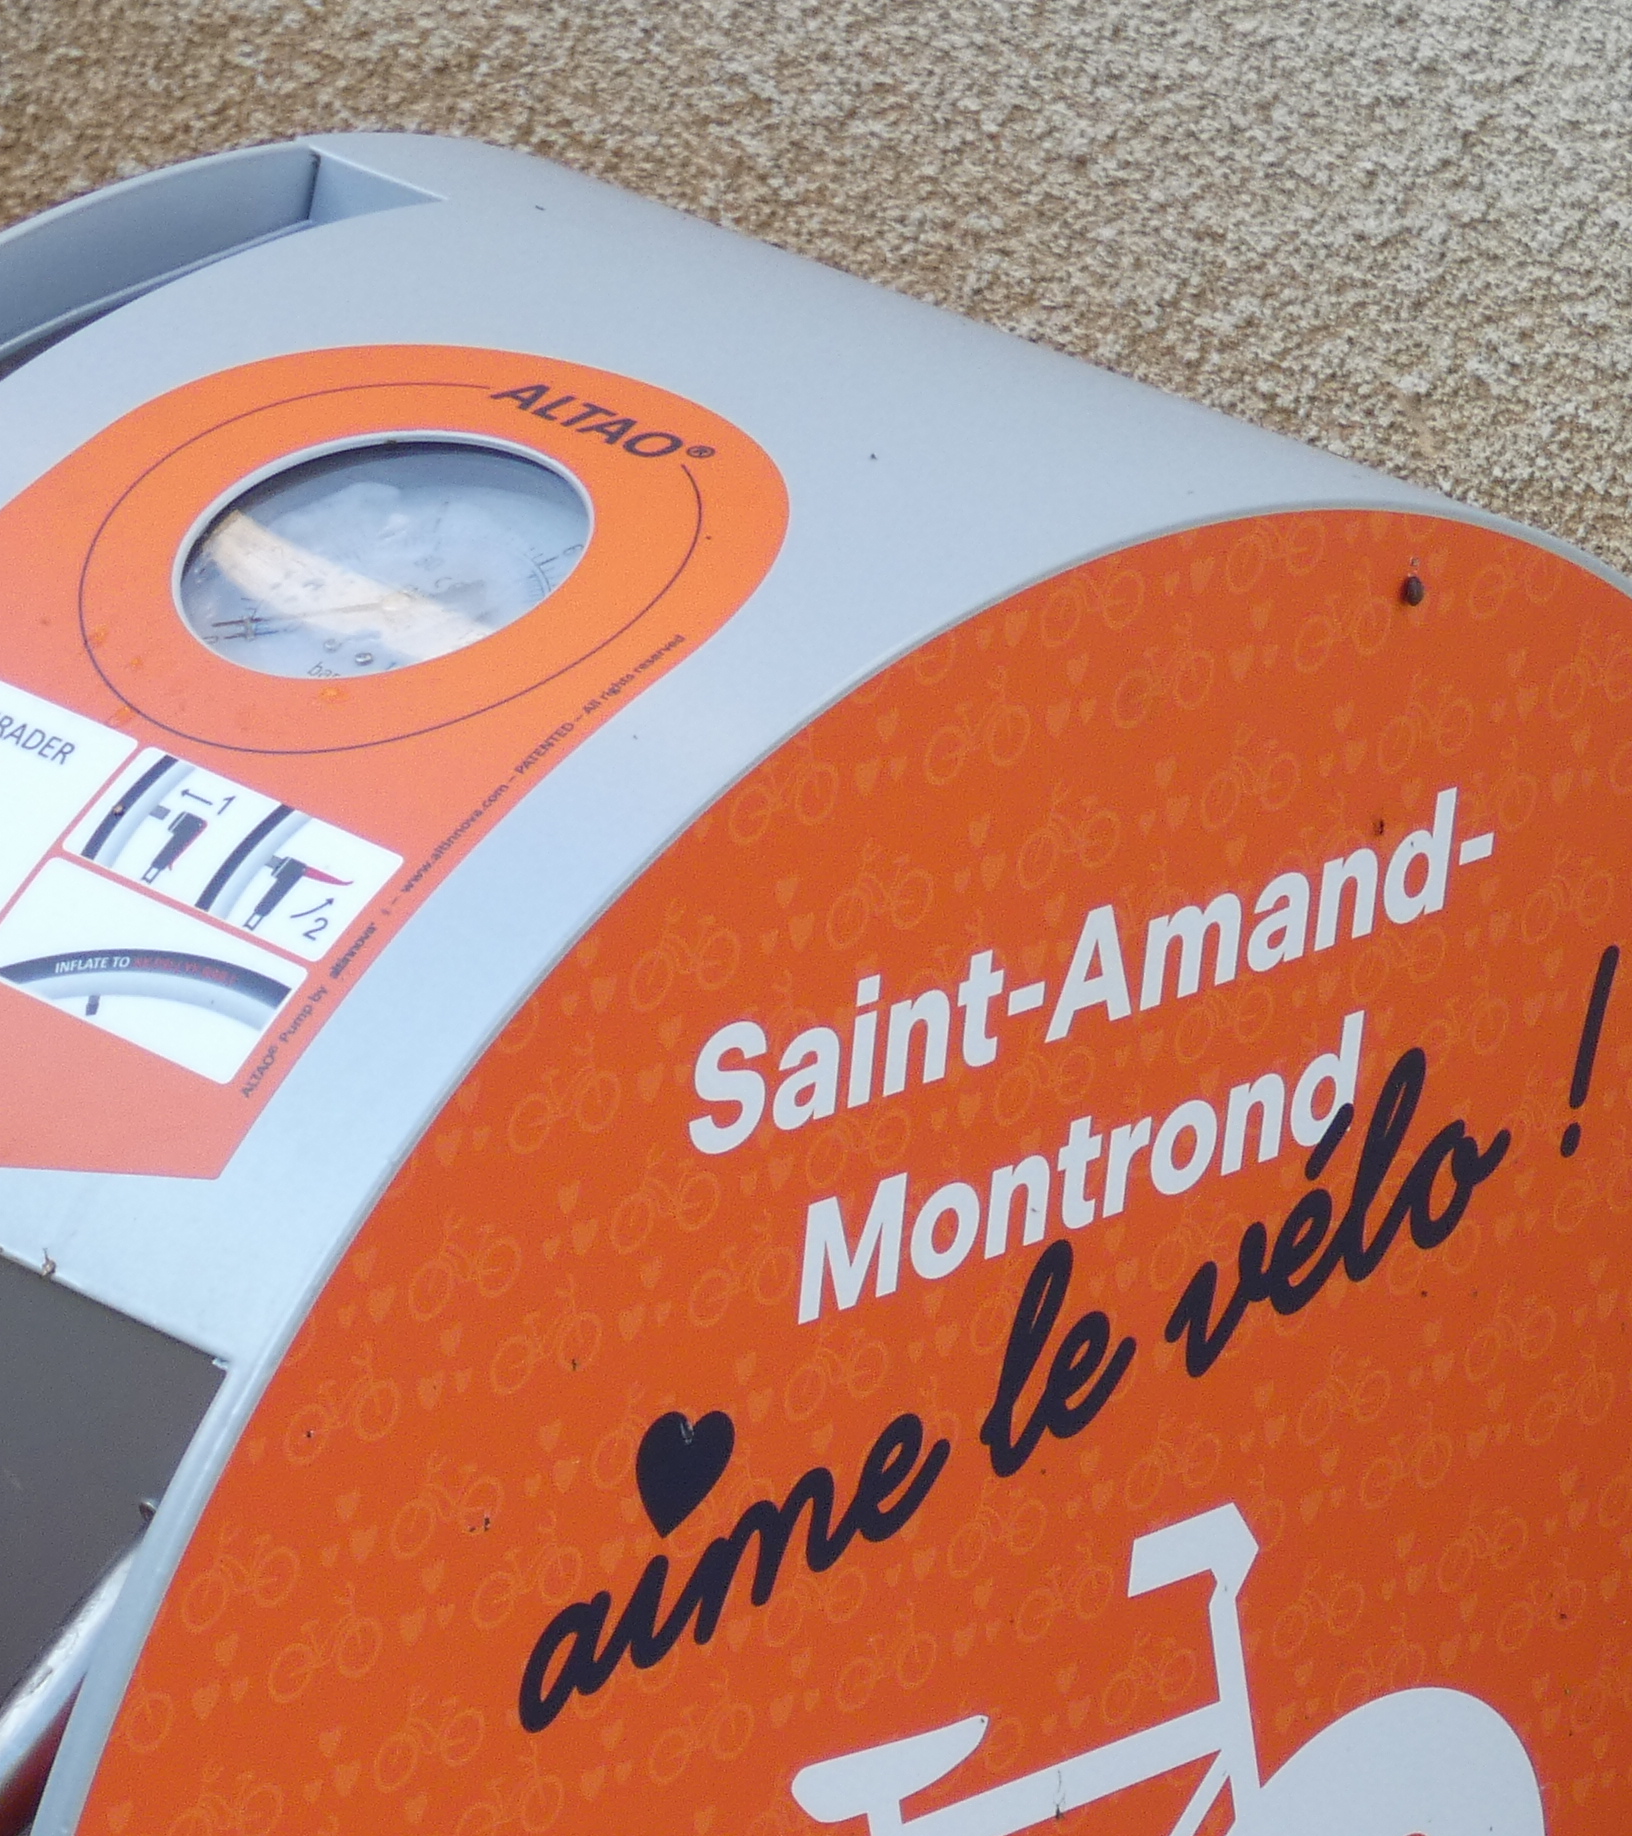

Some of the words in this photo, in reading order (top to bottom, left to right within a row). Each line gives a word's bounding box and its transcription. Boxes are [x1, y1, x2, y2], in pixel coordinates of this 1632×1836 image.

[217, 796, 236, 815] 1
[279, 1003, 313, 1042] Pump
[308, 986, 328, 1003] by
[401, 784, 509, 894] www.altinnova.com
[514, 722, 575, 774] PATENTED
[583, 699, 602, 714] All
[600, 673, 635, 701] rights
[634, 634, 686, 673] reserved
[302, 917, 328, 941] 2
[55, 957, 107, 973] INFLATE
[112, 956, 130, 968] TO
[689, 787, 1495, 1153] Saint-Amand-
[796, 1010, 1365, 1325] Montrond
[519, 1411, 949, 1734] aime
[980, 1240, 1136, 1479] le
[1164, 1047, 1511, 1378] vélo
